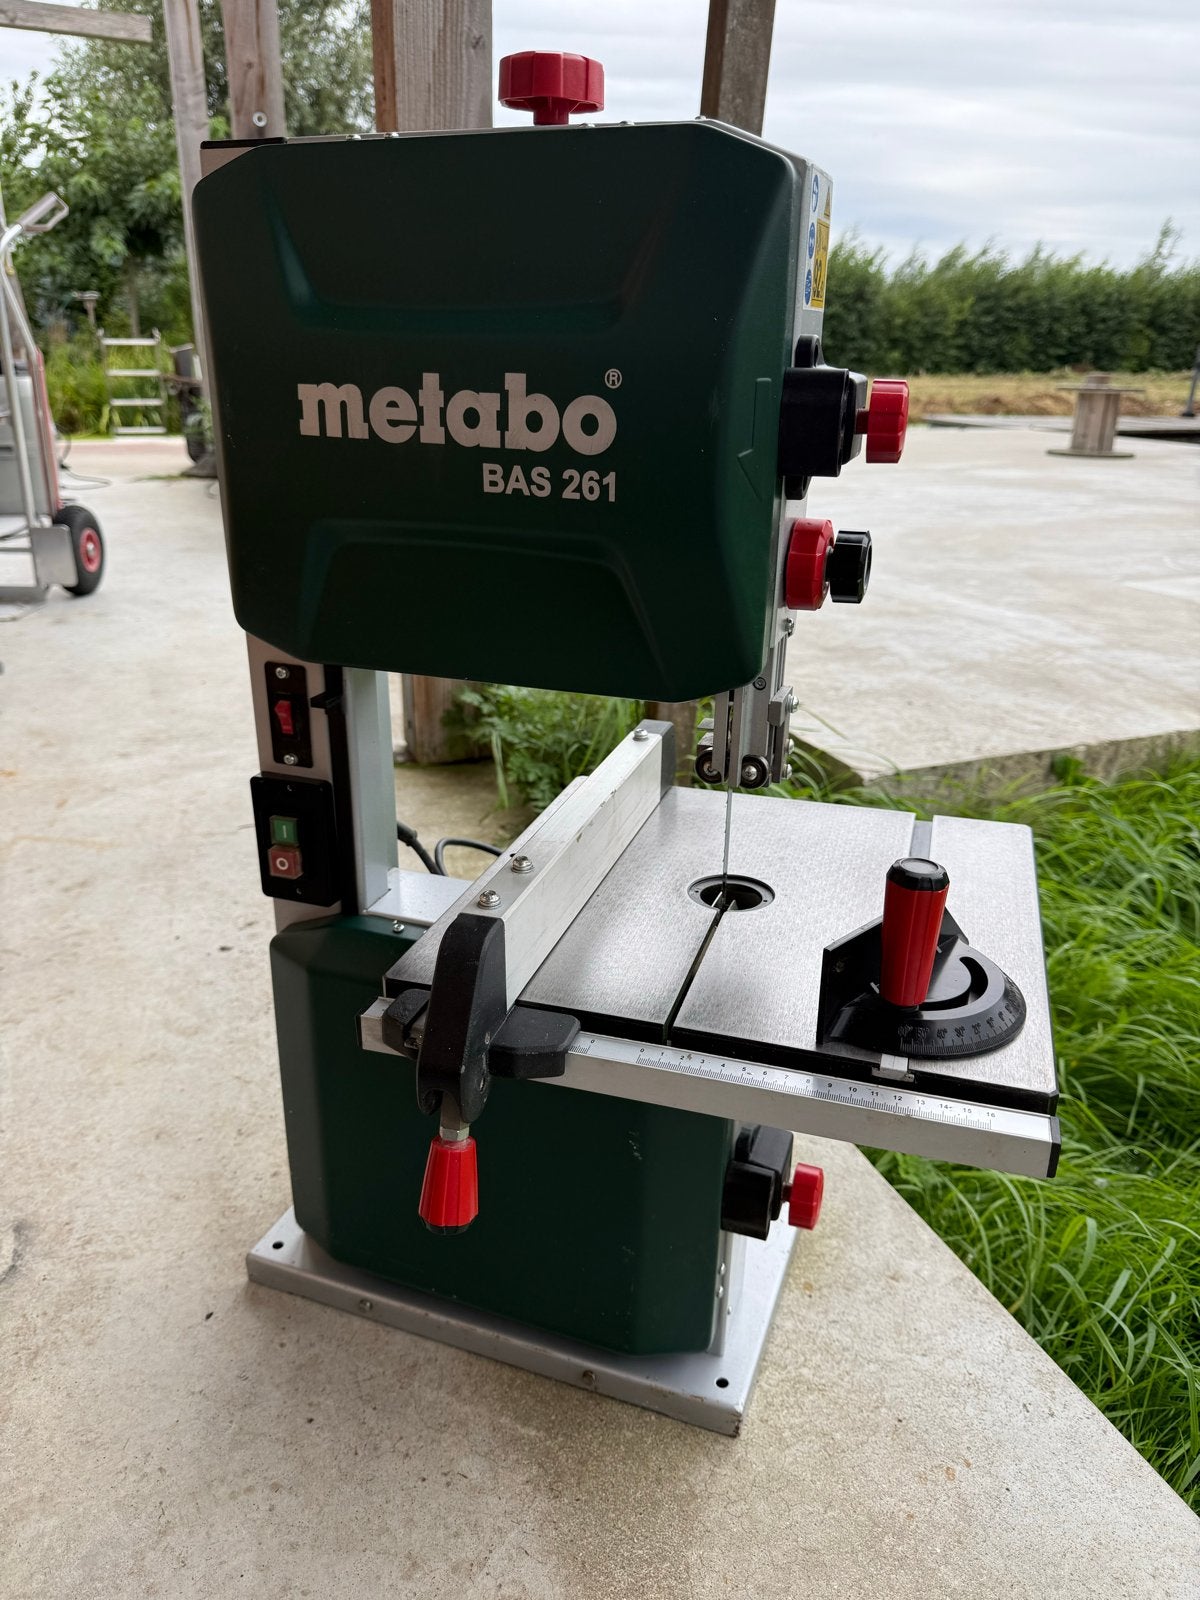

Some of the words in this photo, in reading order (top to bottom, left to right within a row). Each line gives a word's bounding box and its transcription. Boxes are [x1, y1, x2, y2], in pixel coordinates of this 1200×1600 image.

[297, 372, 617, 456] metabo
[482, 462, 552, 498] BAS
[561, 468, 616, 502] 261
